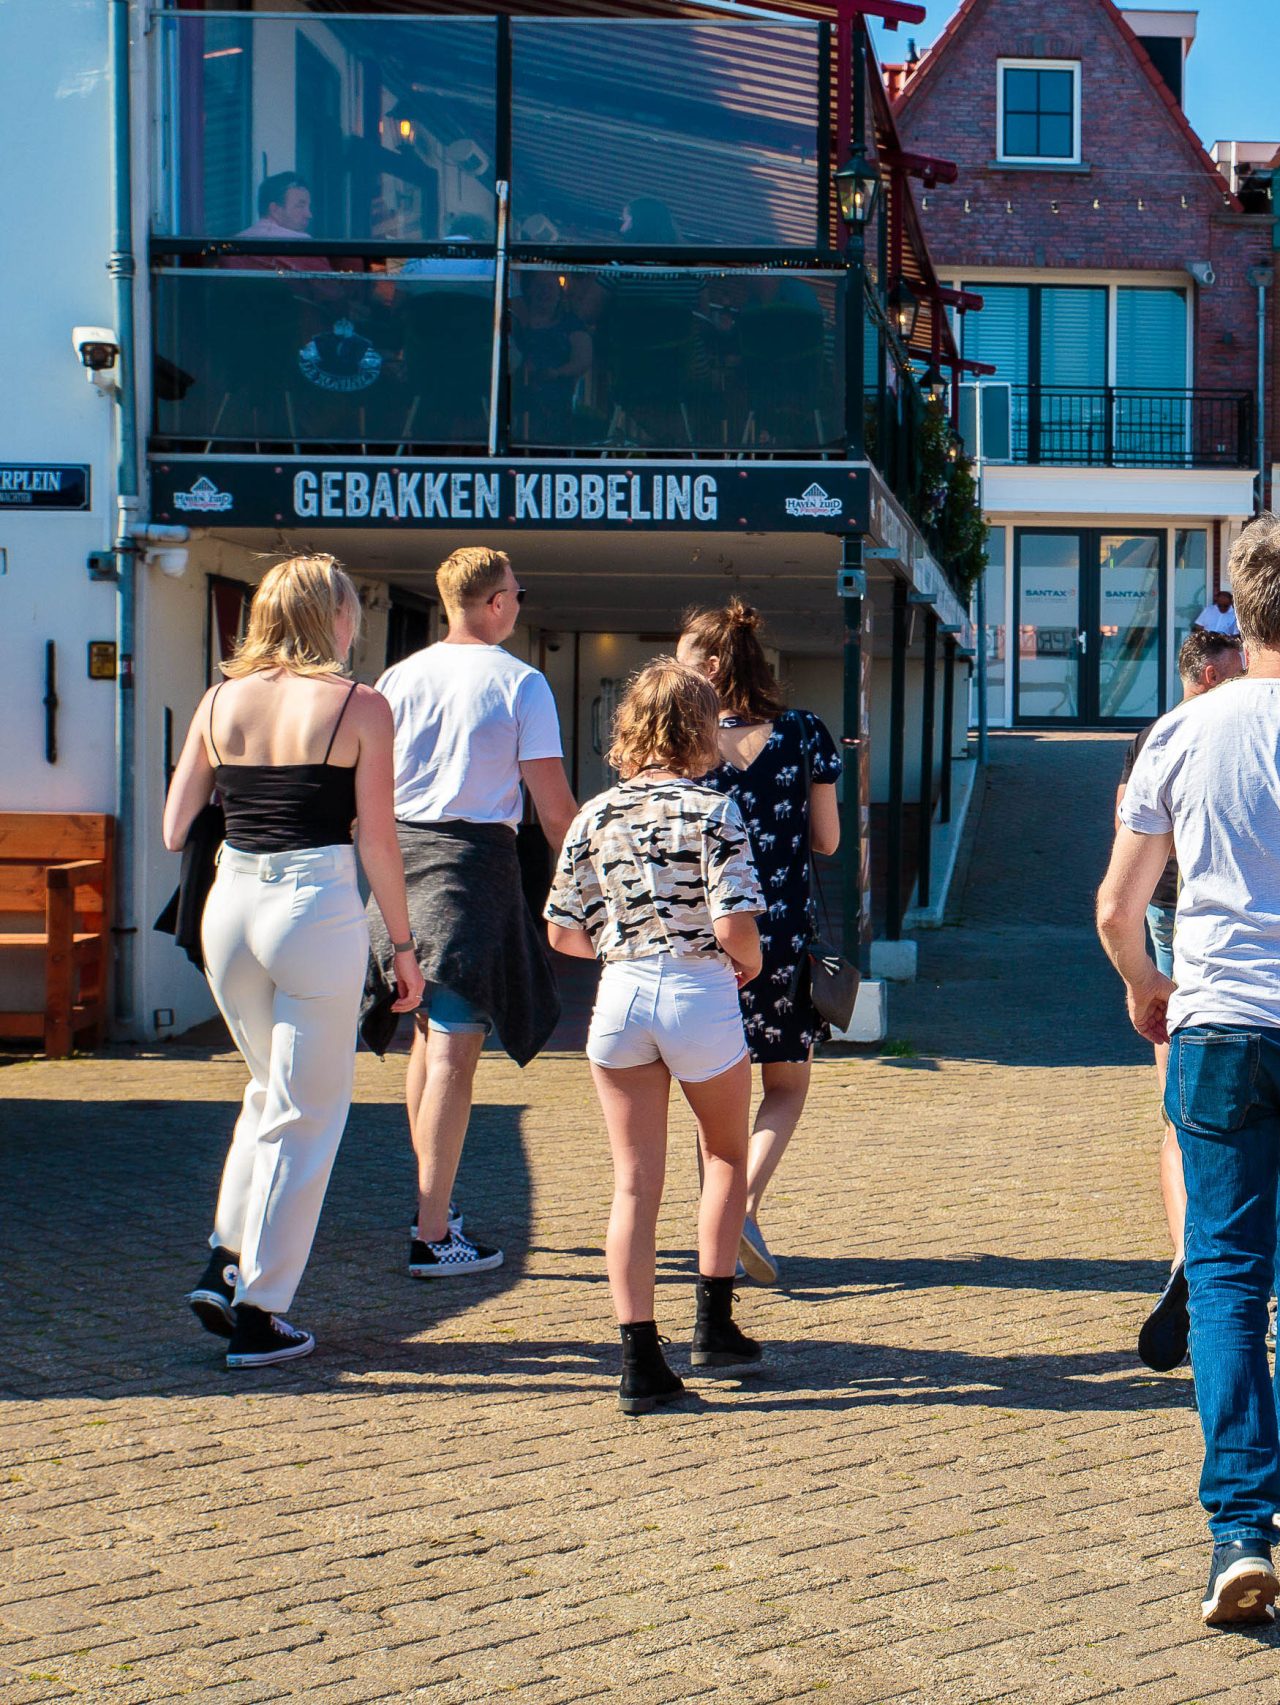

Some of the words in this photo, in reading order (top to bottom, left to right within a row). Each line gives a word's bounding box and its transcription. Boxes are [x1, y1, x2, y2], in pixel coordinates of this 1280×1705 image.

[0, 470, 62, 492] RPLEIN
[293, 471, 499, 519] GEBAKKEN
[514, 473, 718, 521] KIBBELING
[787, 499, 816, 508] HAVEN
[819, 500, 841, 508] ZUID
[1025, 589, 1067, 598] SANTAX
[1105, 590, 1146, 599] SANTAX
